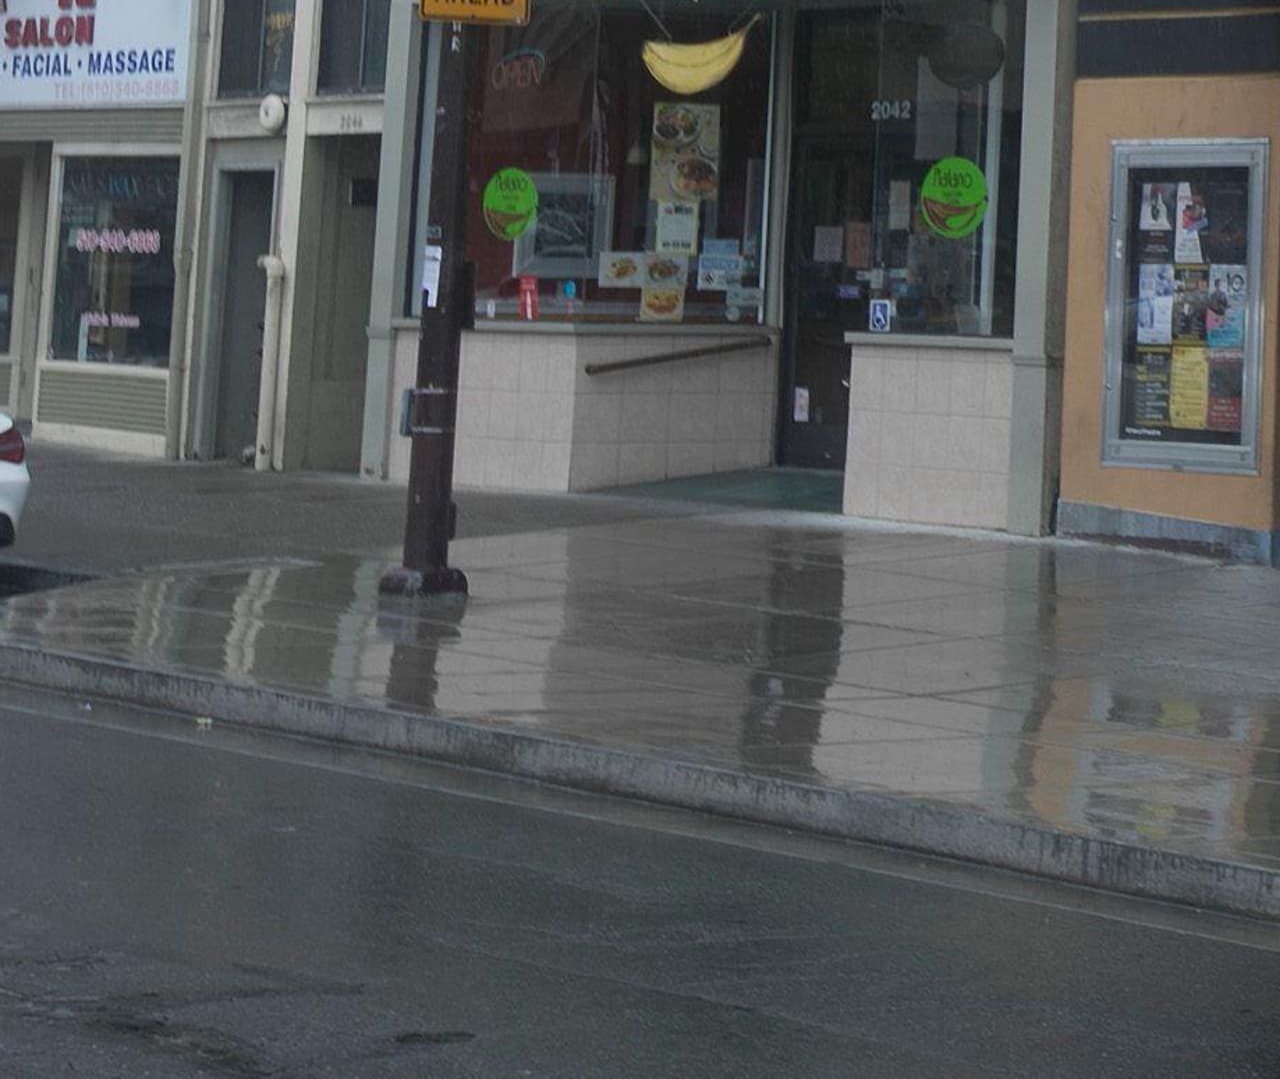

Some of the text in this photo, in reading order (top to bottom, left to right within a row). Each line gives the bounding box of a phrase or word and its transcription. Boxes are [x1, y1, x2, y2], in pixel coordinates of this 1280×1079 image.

[4, 14, 96, 48] SALON
[12, 48, 175, 77] FACIAL MASSAGE
[871, 99, 912, 120] 2042
